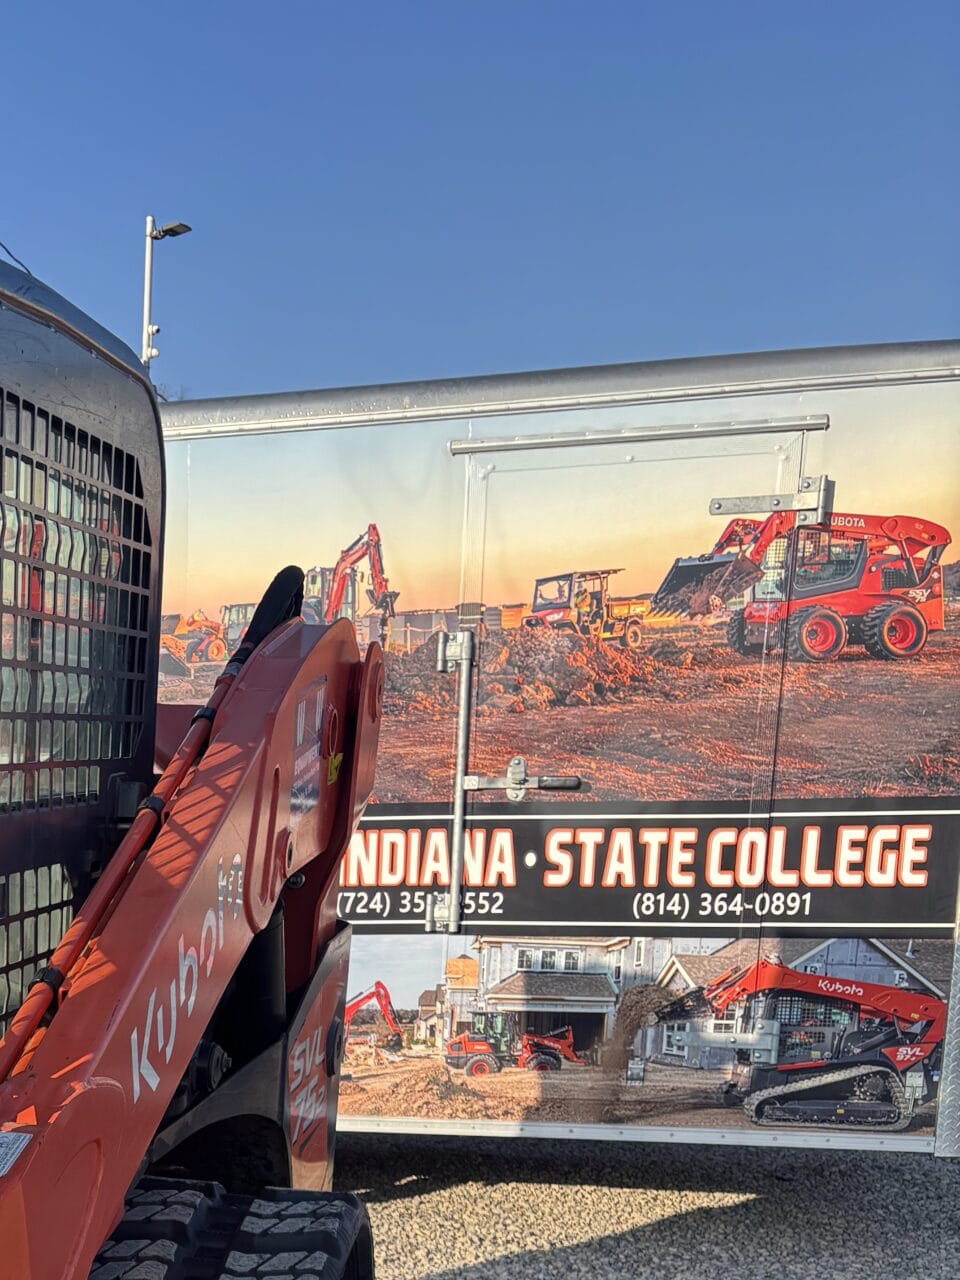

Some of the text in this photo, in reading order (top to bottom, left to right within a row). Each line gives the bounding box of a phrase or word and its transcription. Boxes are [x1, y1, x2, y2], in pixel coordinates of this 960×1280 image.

[830, 516, 866, 528] UBOTA
[543, 827, 699, 888] STATE
[705, 824, 933, 888] COLLEGE
[336, 891, 503, 918] (724) 35552
[632, 892, 812, 919] (814) 364-0891
[130, 853, 243, 1104] Kubota
[817, 979, 864, 996] Kubota
[290, 1025, 325, 1093] SVL
